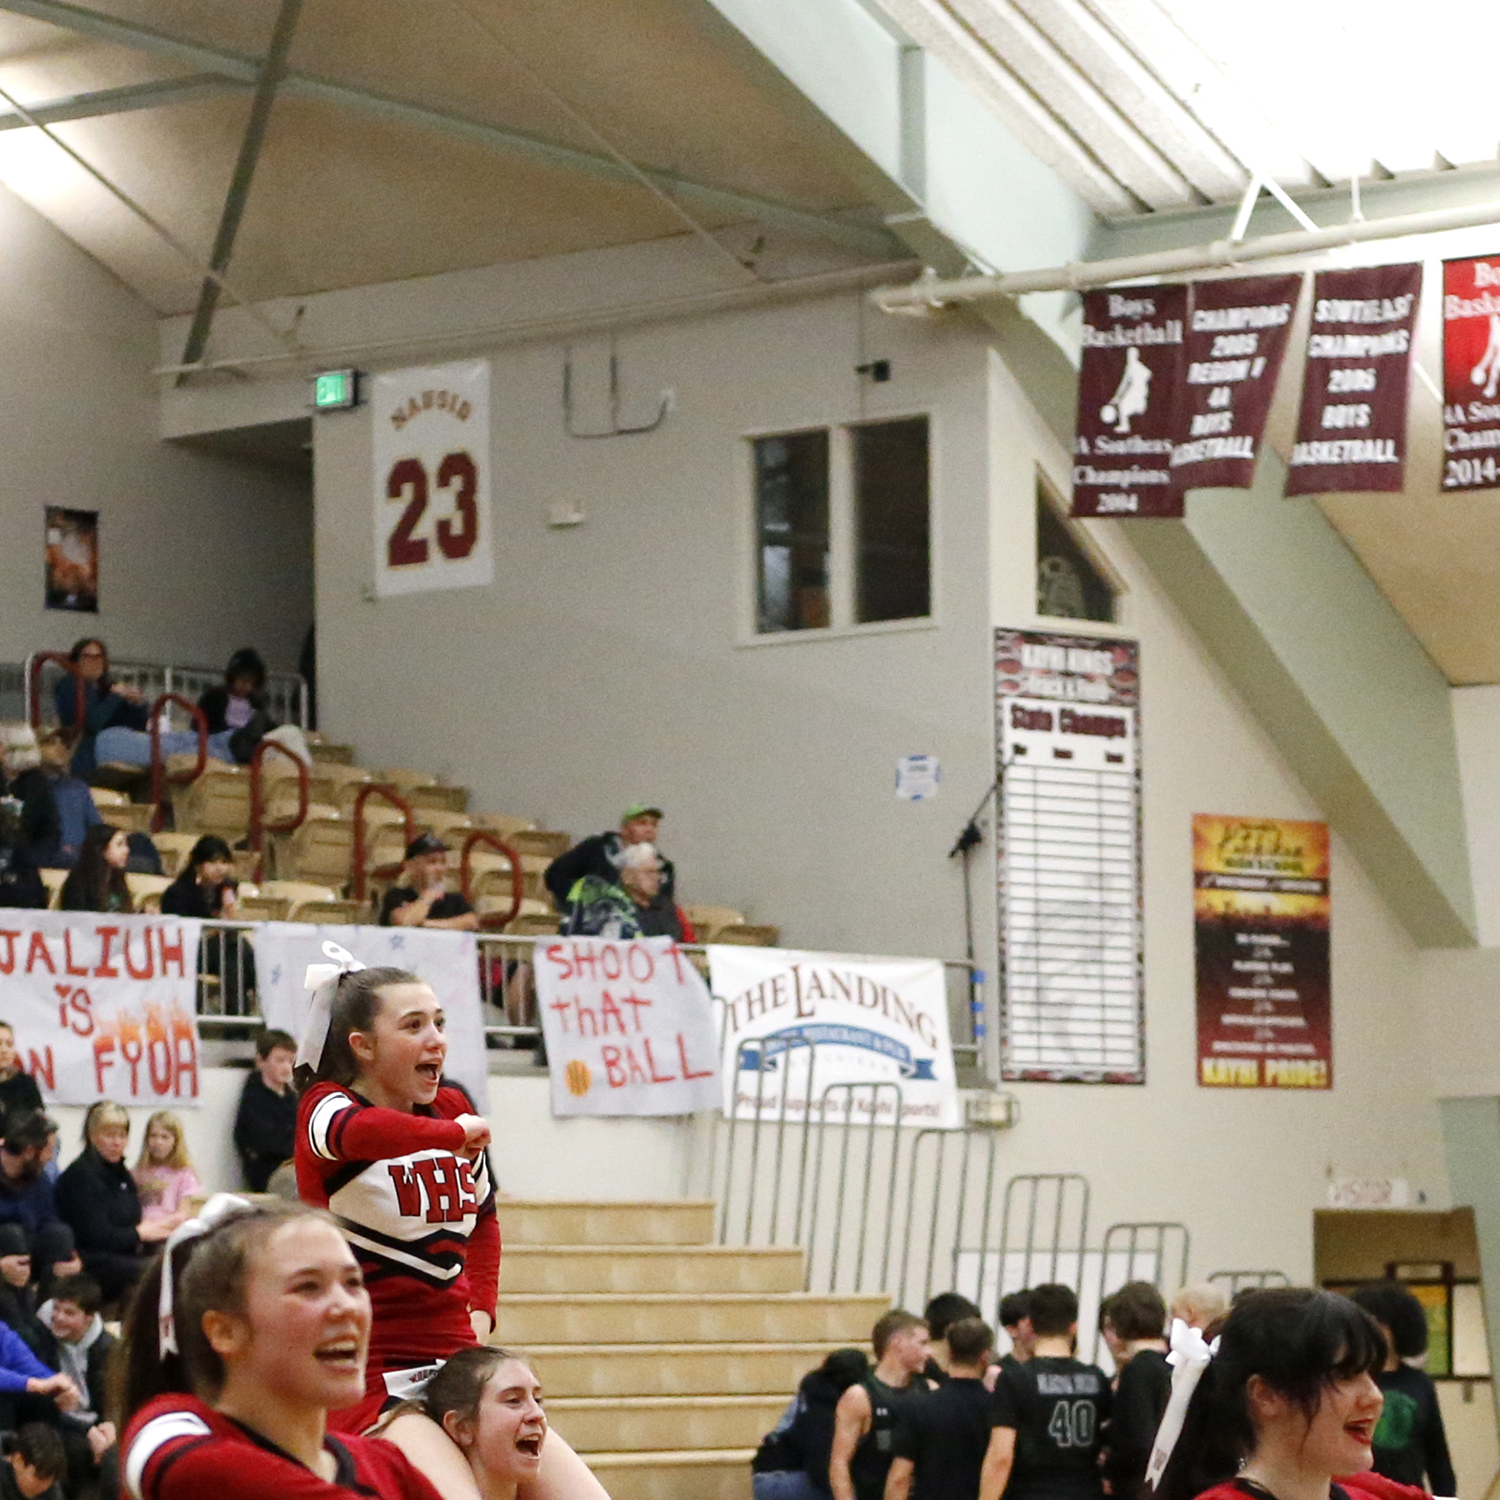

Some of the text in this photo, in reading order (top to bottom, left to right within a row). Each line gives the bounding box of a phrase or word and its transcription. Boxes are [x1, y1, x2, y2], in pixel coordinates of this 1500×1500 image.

[1108, 295, 1155, 319] Boys
[1191, 303, 1292, 332] CHAMPIONS
[1081, 320, 1183, 347] Basketball
[1309, 329, 1409, 358] CHAMPIONS
[1190, 411, 1233, 436] BOYS
[1320, 403, 1372, 429] BOYS
[1072, 464, 1171, 489] Champions
[387, 452, 478, 567] 23
[725, 973, 788, 1034] THE
[601, 1033, 713, 1089] BALL
[388, 1156, 479, 1223] WHS
[1047, 1400, 1097, 1448] 40
